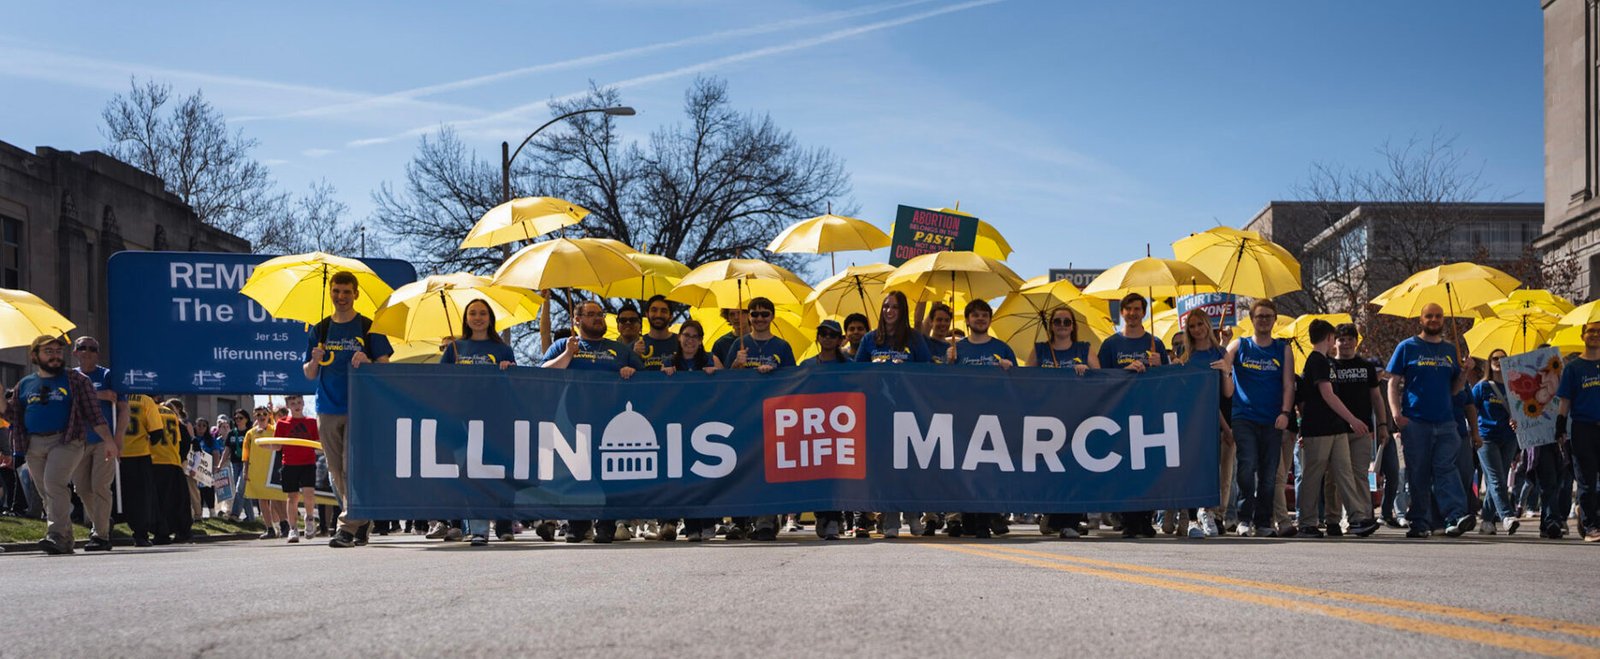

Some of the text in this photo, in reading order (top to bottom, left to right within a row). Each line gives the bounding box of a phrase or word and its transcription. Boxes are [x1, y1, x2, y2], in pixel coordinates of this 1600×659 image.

[909, 223, 938, 233] BELONGS
[912, 210, 961, 231] ABORTION
[913, 231, 955, 247] PAST
[169, 262, 255, 289] REM
[172, 298, 234, 322] The
[1184, 293, 1222, 311] HURTS
[255, 332, 289, 341] Jer 1:5
[213, 347, 306, 362] liferunners.
[775, 404, 856, 437] PRO
[893, 412, 1180, 473] MARCH
[775, 437, 856, 470] LIFE
